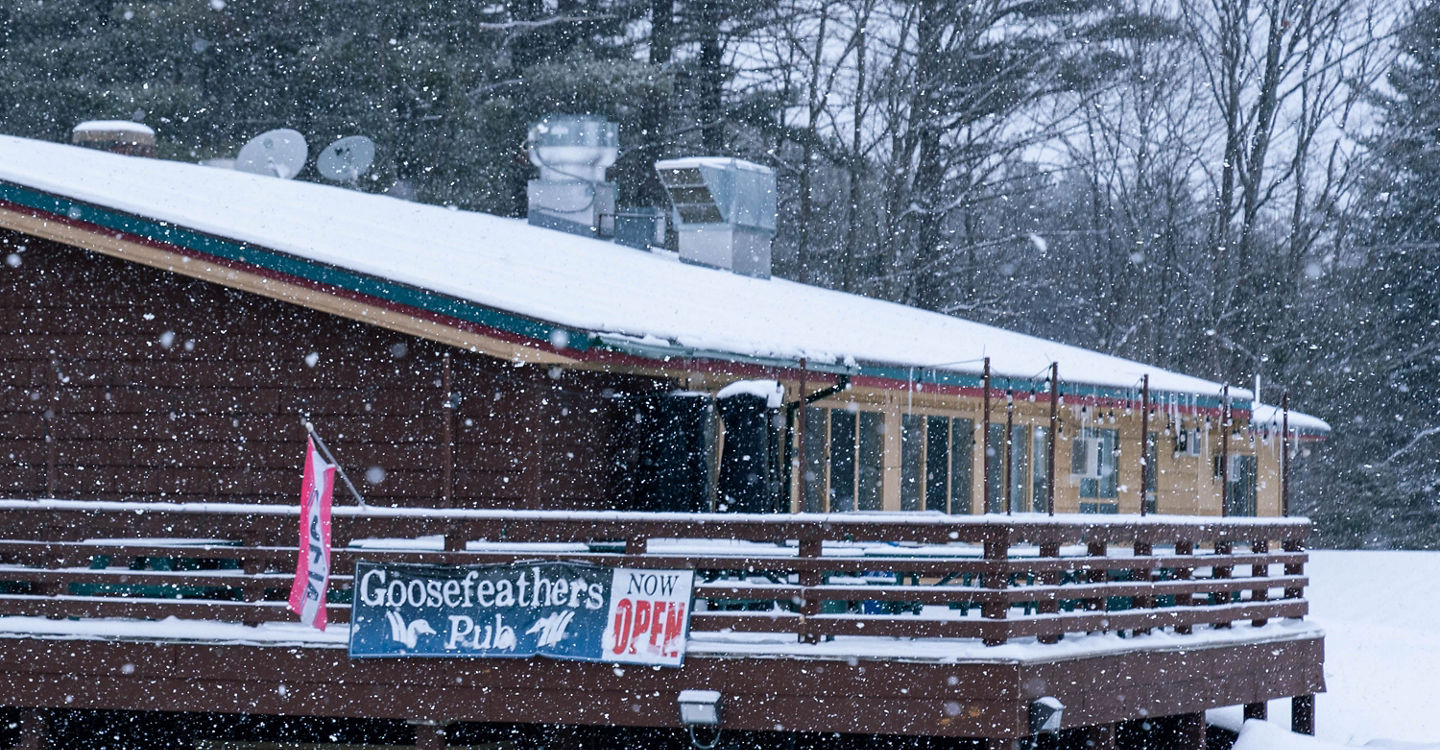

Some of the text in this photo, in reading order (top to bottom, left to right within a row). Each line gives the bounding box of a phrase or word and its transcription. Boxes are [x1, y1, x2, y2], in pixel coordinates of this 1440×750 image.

[360, 566, 604, 610] Goosefeathers
[627, 573, 680, 596] NOW
[446, 614, 515, 651] Pub
[612, 598, 686, 658] OPEN
